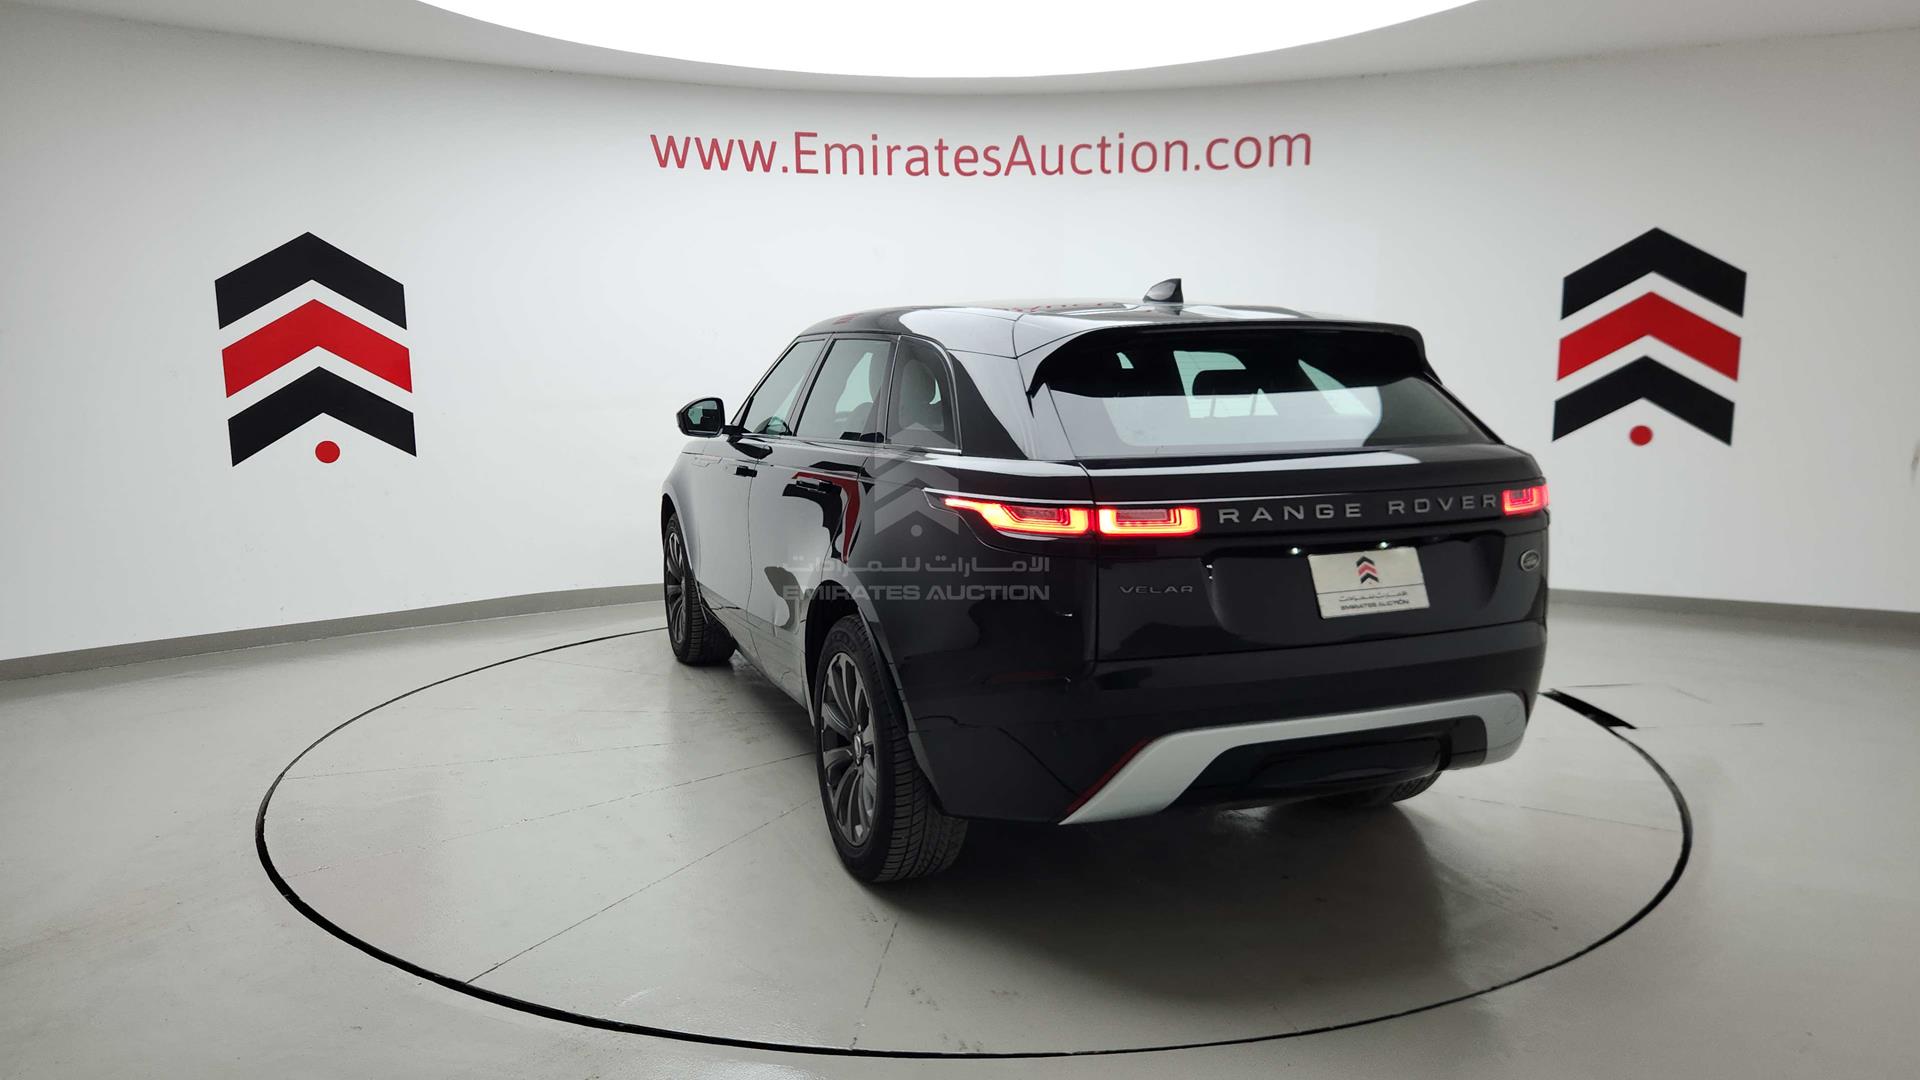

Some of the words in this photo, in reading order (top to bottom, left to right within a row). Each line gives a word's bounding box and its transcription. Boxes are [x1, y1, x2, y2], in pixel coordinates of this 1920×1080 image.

[649, 130, 1313, 178] www.EmiratesAuction.com
[1218, 503, 1362, 524] RANGE
[1388, 494, 1497, 515] ROVER
[1119, 585, 1194, 594] VELAR
